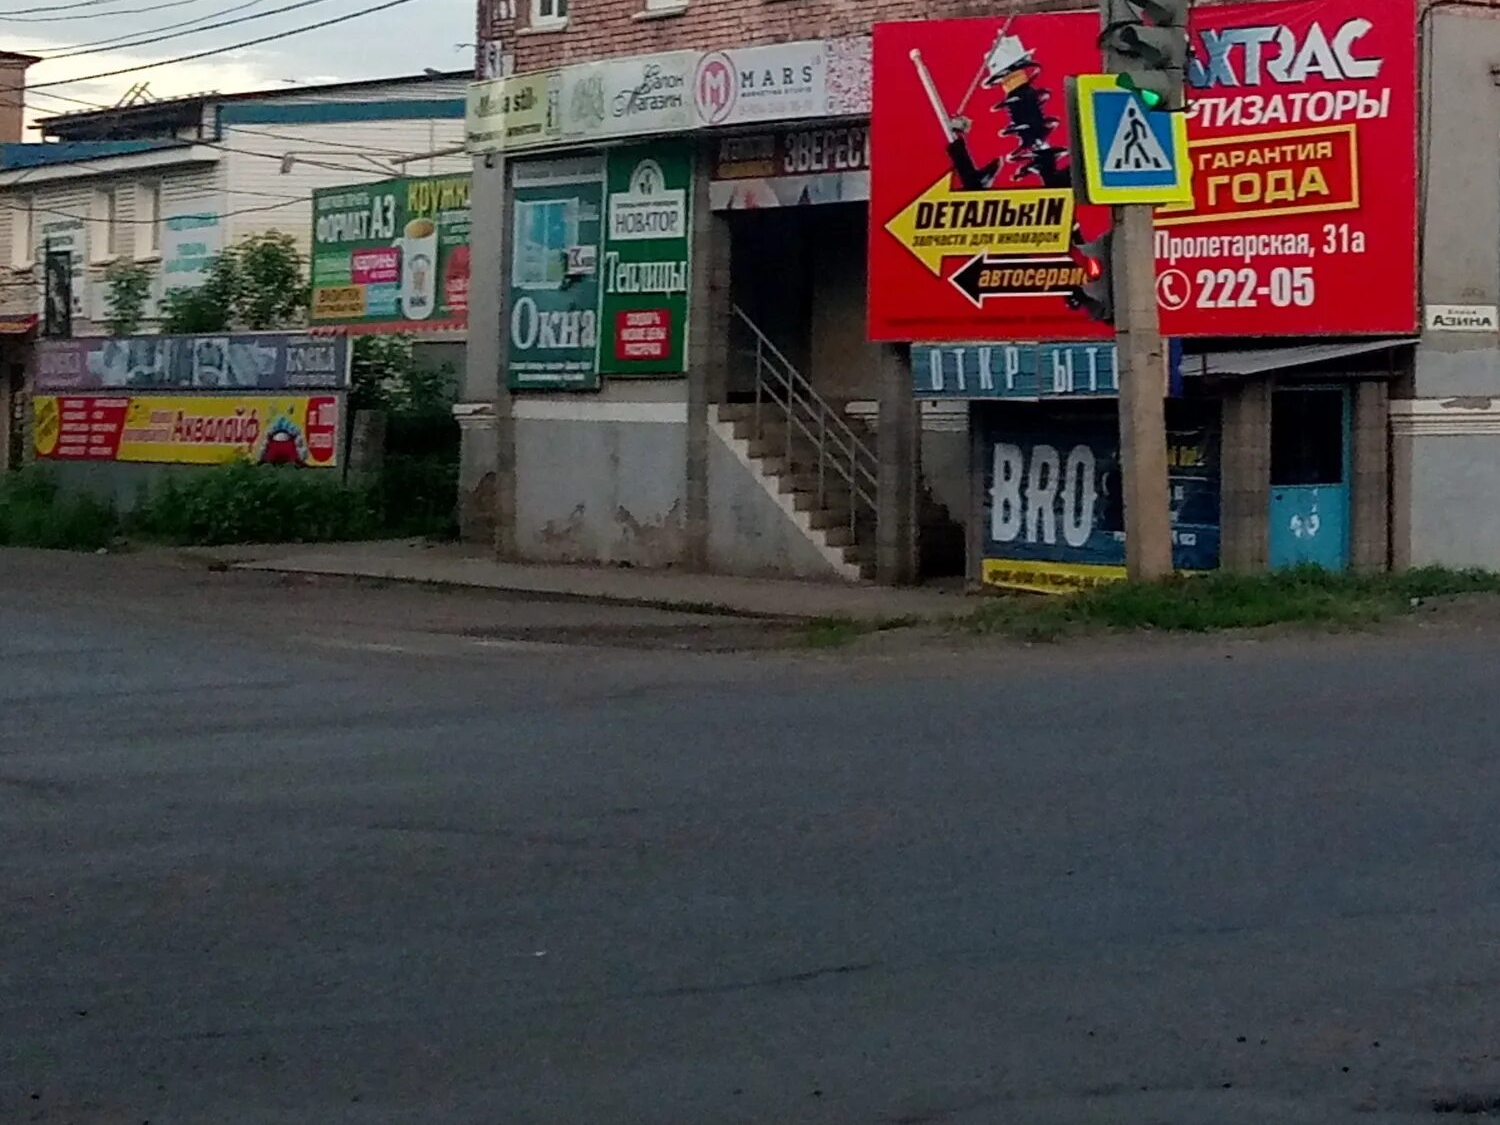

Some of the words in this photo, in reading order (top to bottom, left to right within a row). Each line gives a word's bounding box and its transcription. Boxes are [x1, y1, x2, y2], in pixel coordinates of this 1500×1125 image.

[740, 65, 813, 88] MARS
[1198, 142, 1333, 171] ГАРАНТИЯ
[1207, 166, 1330, 206] ГОДА
[370, 194, 397, 239] А3
[615, 211, 679, 233] НОВАТОР
[913, 233, 967, 248] запчасти
[969, 233, 994, 248] для
[997, 231, 1061, 249] иномарок
[1155, 229, 1316, 266] Пролетарская,
[1322, 223, 1366, 254] 31а
[606, 252, 688, 299] Теплицы
[1195, 266, 1316, 308] 222-05
[511, 296, 596, 349] Окна
[1432, 315, 1492, 327] АЗИНА
[989, 441, 1098, 547] BRO
